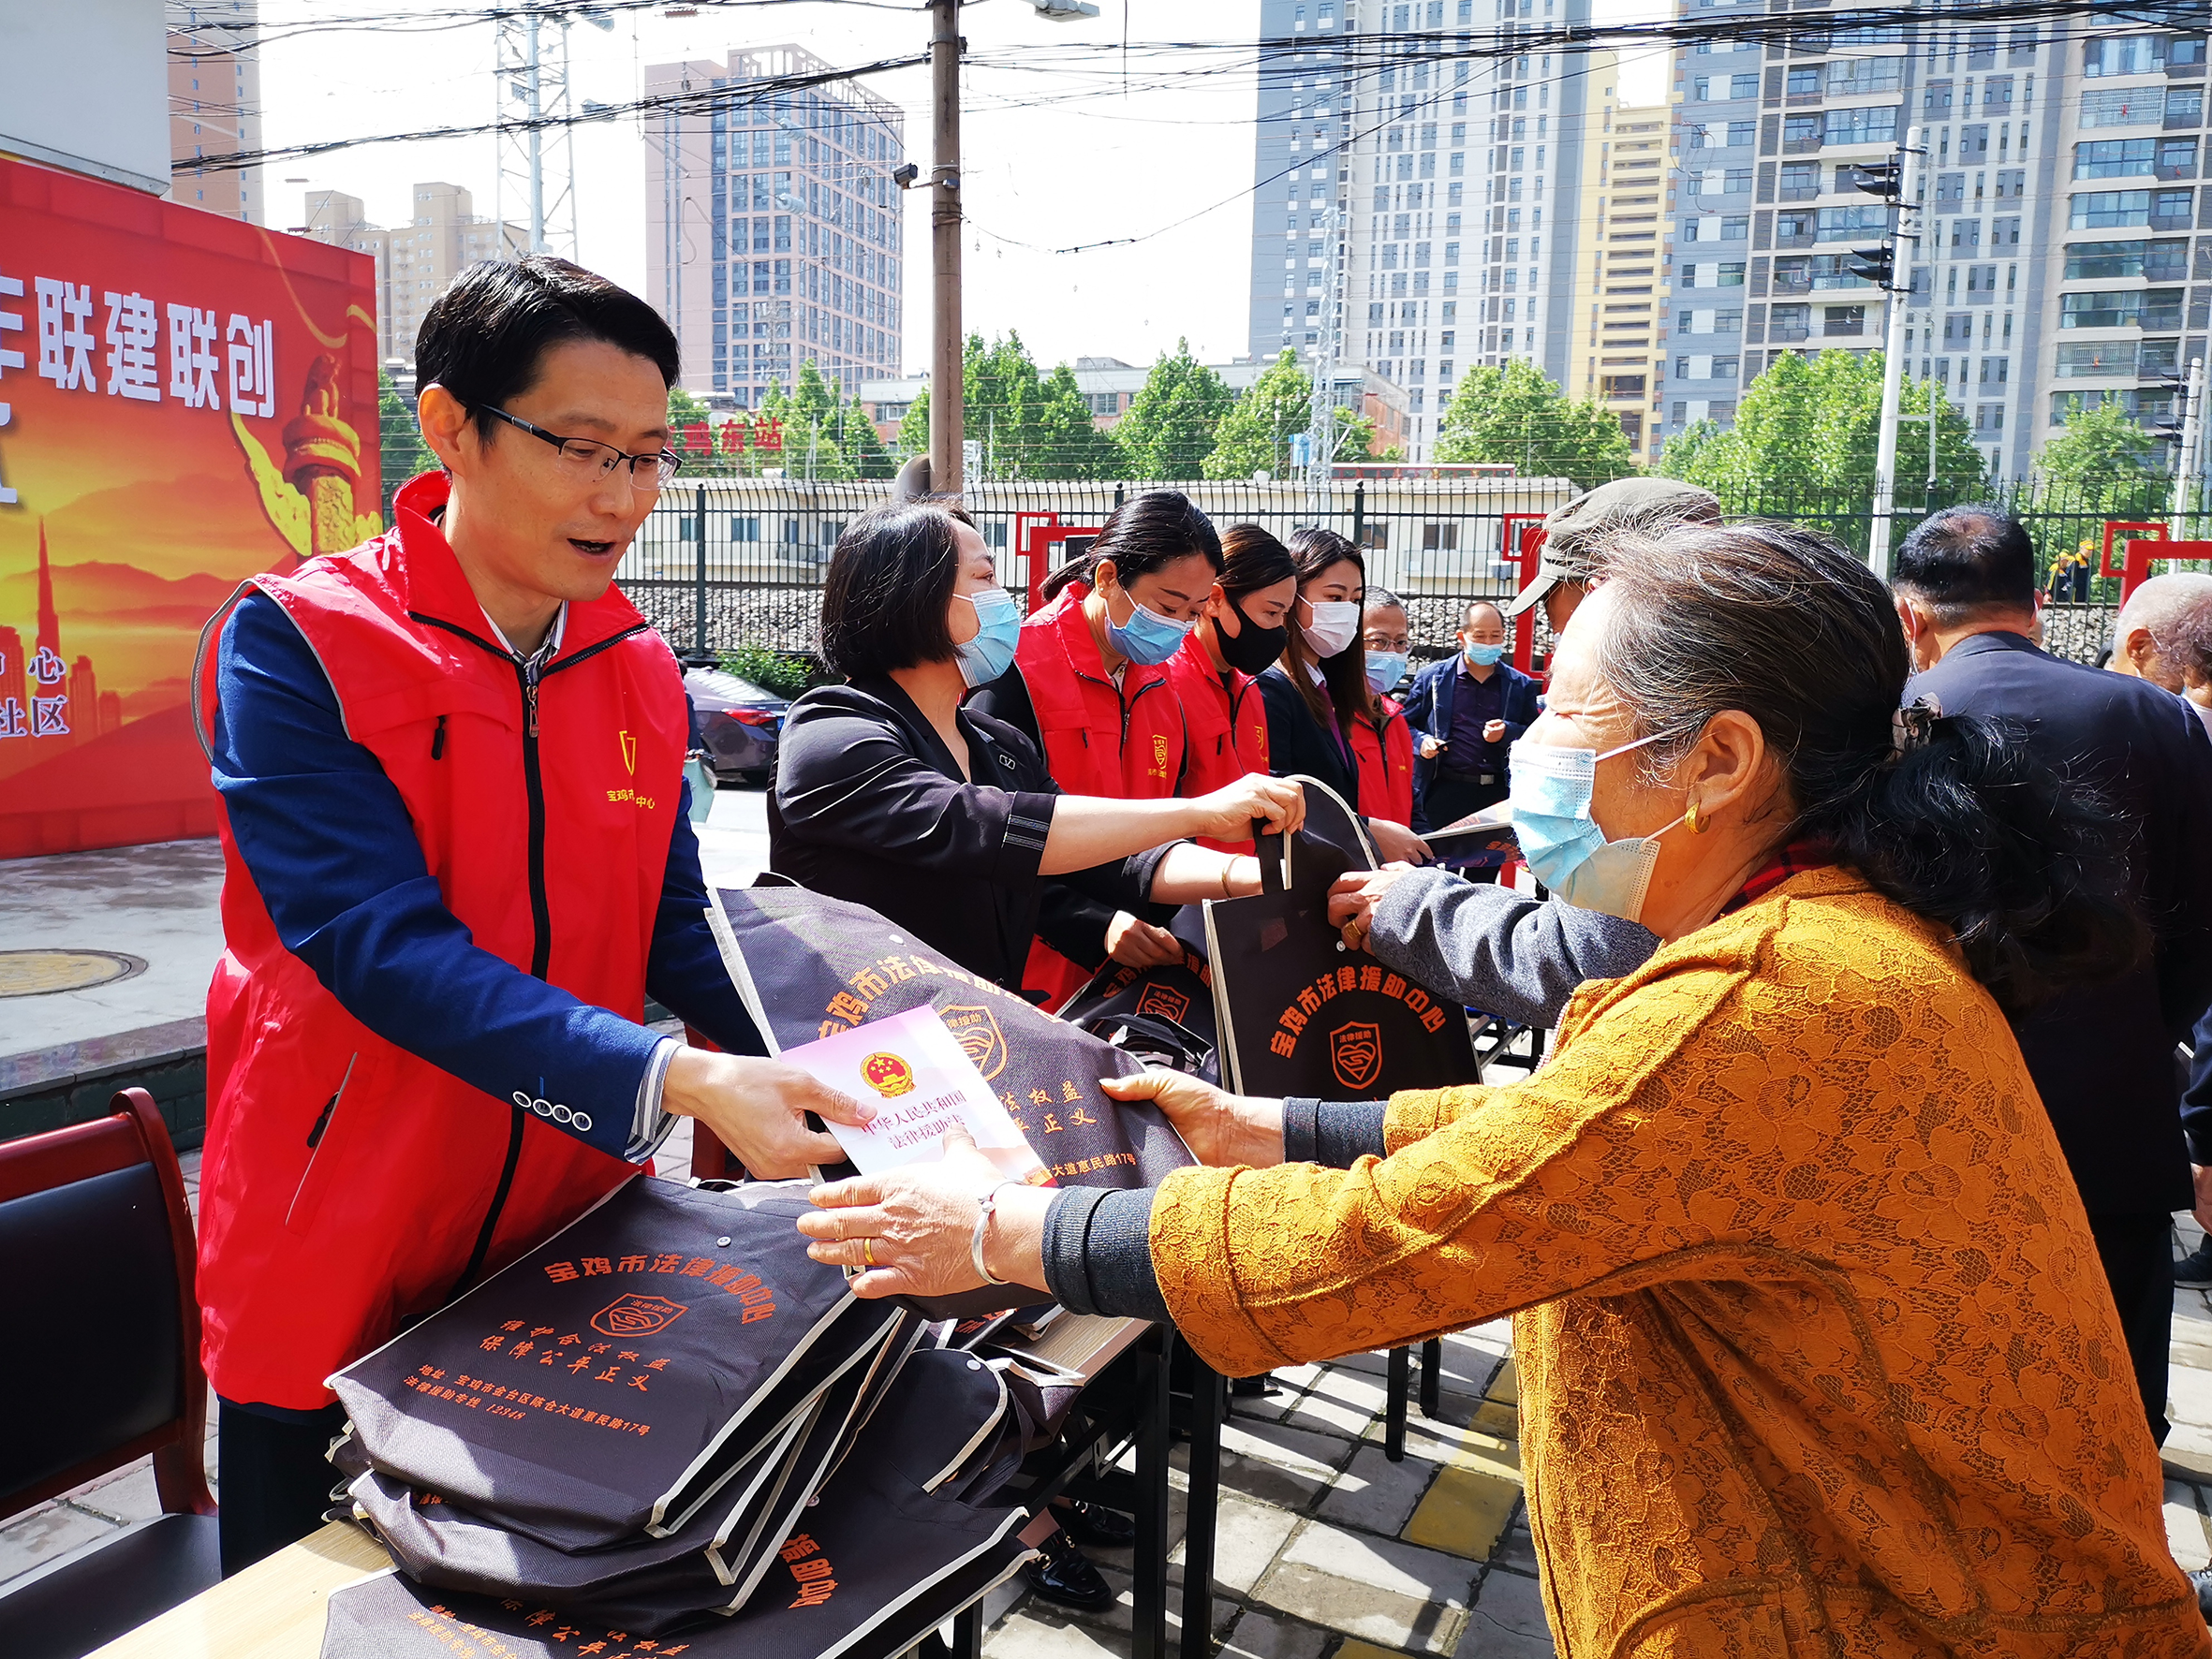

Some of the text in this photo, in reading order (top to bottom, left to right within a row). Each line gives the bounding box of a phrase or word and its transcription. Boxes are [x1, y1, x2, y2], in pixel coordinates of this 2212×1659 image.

[1269, 964, 1447, 1060] 宝鸡市法律援助中心
[1338, 1030, 1373, 1044] 法律援助
[862, 1089, 967, 1136] 中华人民共和国
[543, 1253, 776, 1325] 宝鸡市法律援助中心
[479, 1334, 650, 1392] 保障公平正义
[499, 1319, 671, 1372] 维护合法权益
